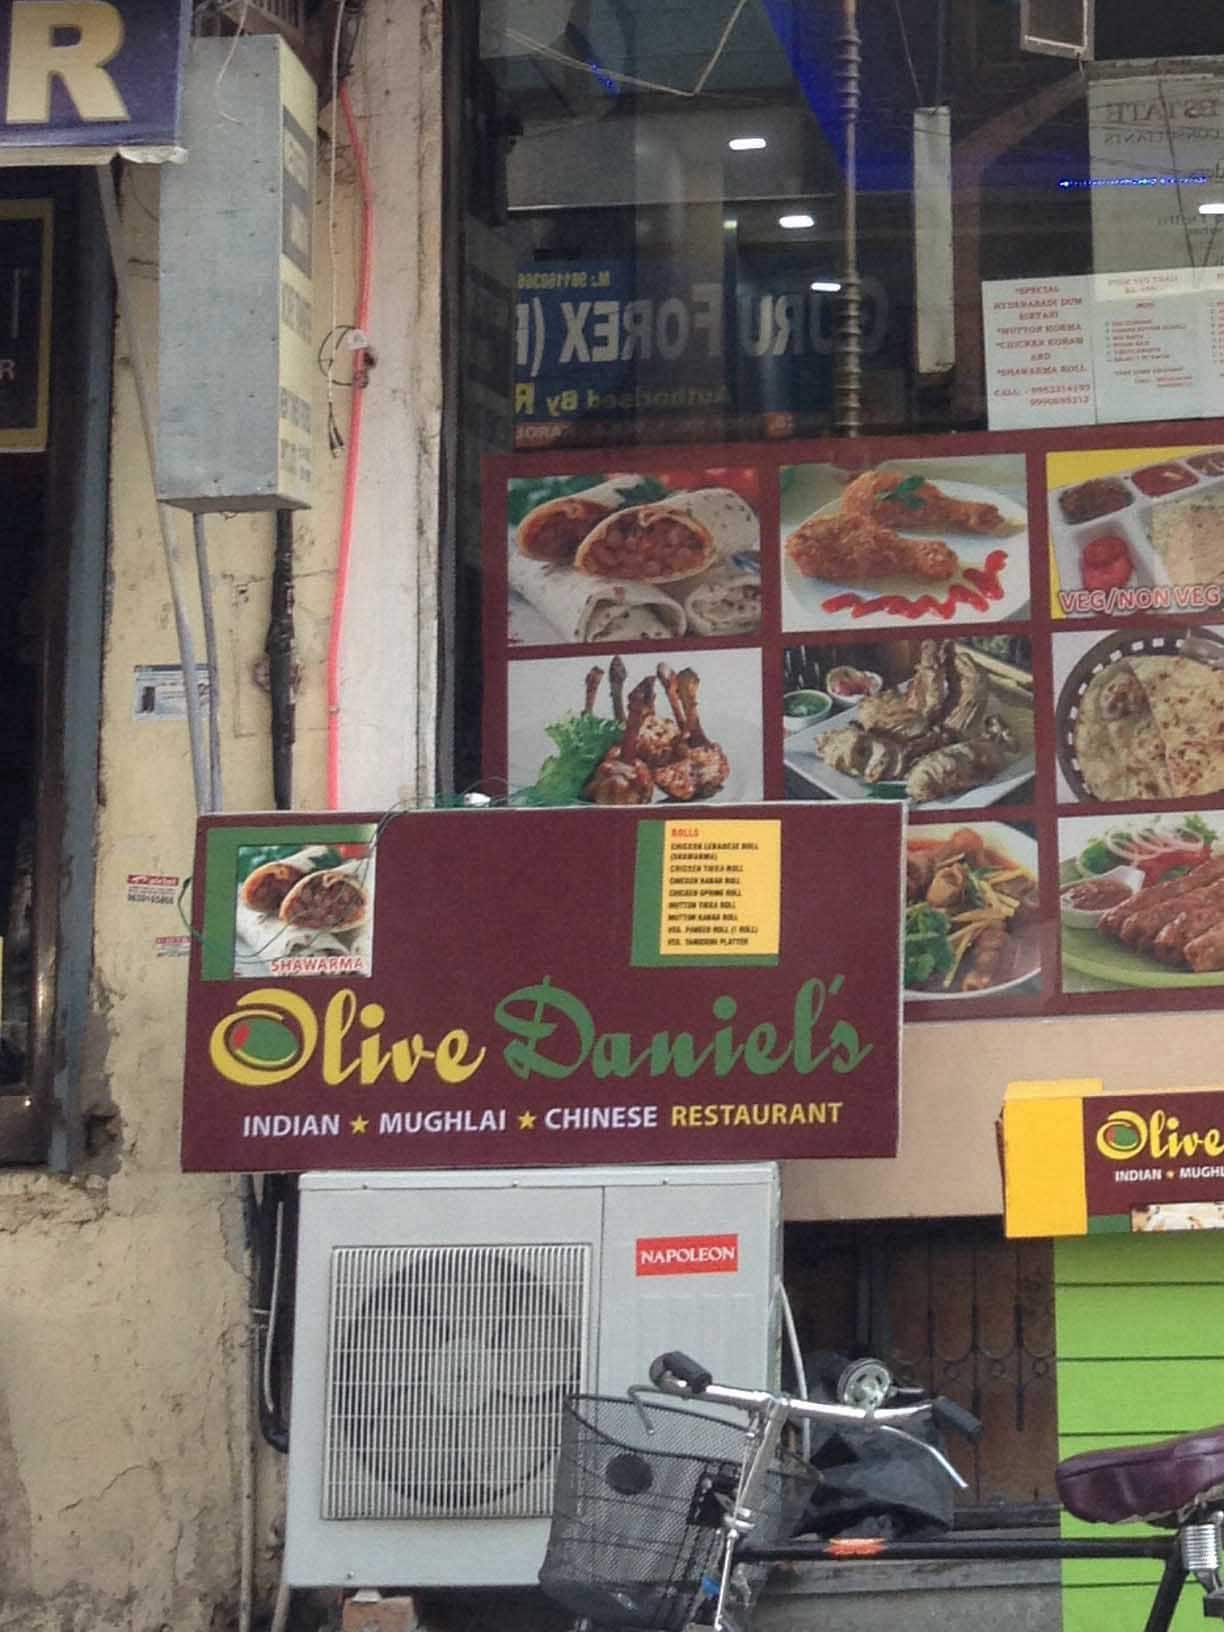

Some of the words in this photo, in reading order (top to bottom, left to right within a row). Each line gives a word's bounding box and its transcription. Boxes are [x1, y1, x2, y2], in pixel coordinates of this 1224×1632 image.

[1060, 587, 1170, 613] VEG/NON
[1174, 584, 1222, 607] VEG
[271, 956, 365, 972] SHAWARMA
[209, 987, 487, 1087] Olive
[494, 974, 873, 1080] Daniel's
[242, 1113, 341, 1138] INDIAN
[378, 1109, 507, 1135] MUGHLAI
[544, 1105, 658, 1131] CHINESE
[671, 1101, 844, 1127] RESTAURANT
[1114, 1168, 1163, 1183] INDIAN
[640, 1245, 736, 1265] NAPOLEON
